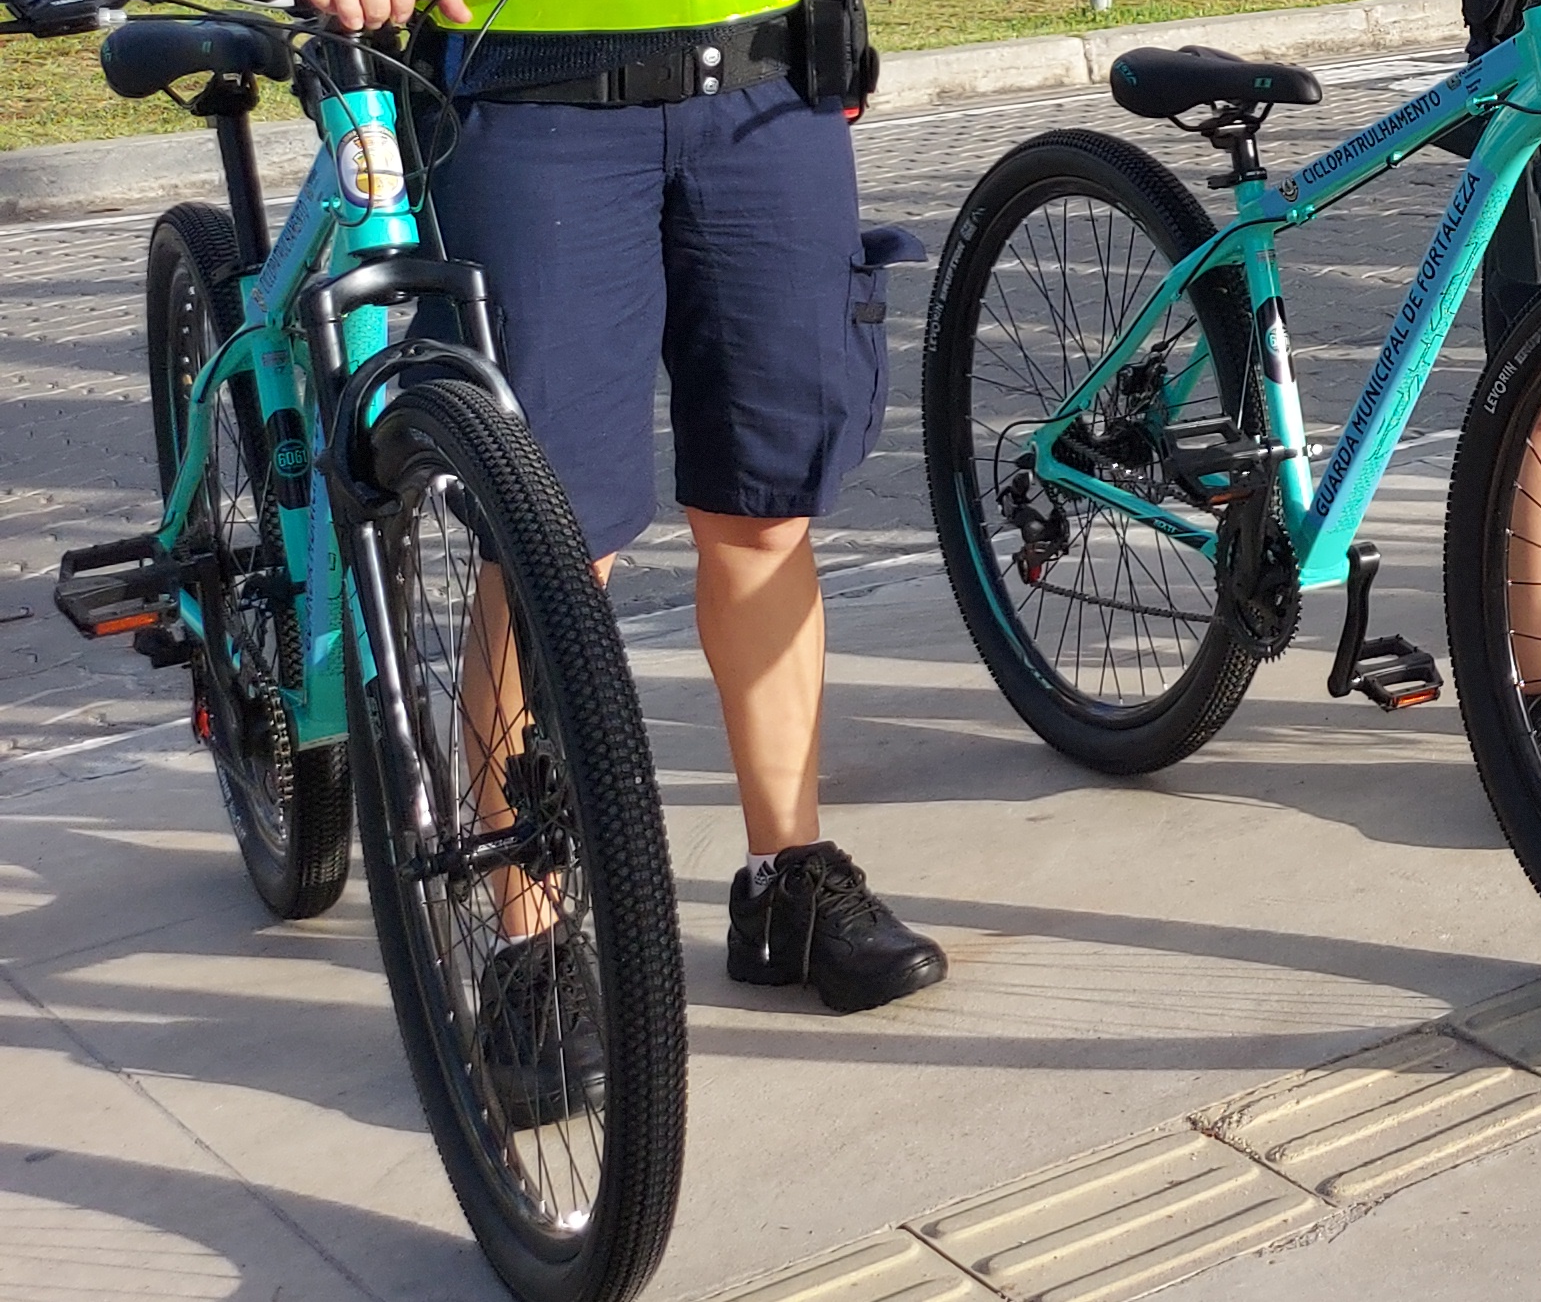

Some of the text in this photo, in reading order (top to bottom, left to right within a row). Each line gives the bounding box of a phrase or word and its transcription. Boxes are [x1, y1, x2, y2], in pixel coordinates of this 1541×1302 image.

[1302, 89, 1442, 185] CICLOPATRULHAMENTO
[1315, 172, 1482, 519] GUARDA MUNICIPAL DE FORTALEZA
[1483, 360, 1518, 415] LEVORIN
